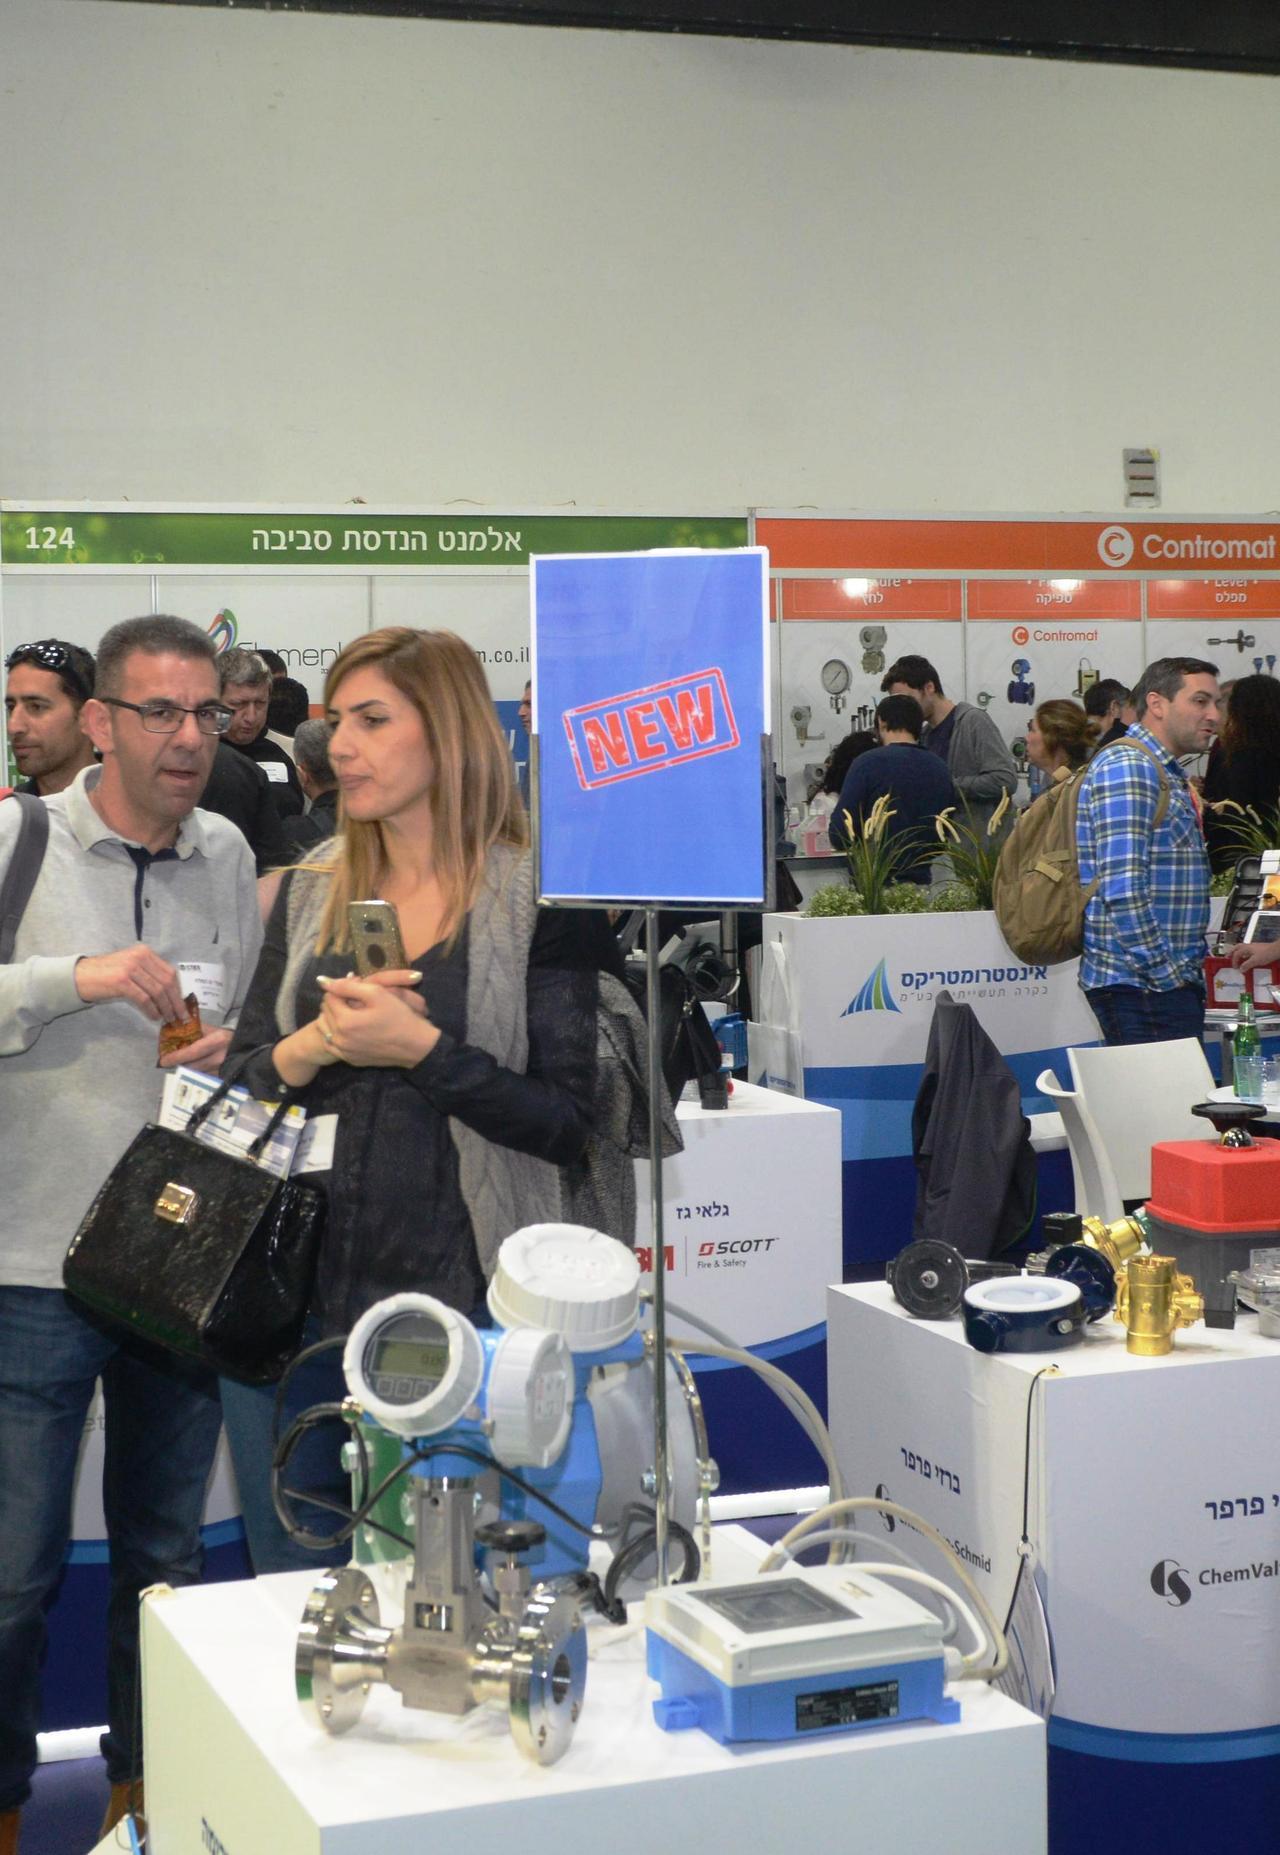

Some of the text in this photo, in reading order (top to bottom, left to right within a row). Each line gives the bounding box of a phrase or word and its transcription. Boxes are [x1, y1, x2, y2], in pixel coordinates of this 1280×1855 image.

[25, 527, 75, 549] 124
[252, 526, 522, 552] אלמנט הנדסת סביבה
[1143, 535, 1277, 559] Contromat
[1215, 592, 1248, 604] מפלס
[1033, 629, 1099, 642] Contromat
[582, 683, 717, 773] NEW
[901, 965, 1048, 989] אינסטרומטריקס
[951, 988, 1007, 1000] תעשייתי
[676, 1201, 730, 1220] גלאי גז
[697, 1259, 747, 1269] Fire & Safety
[901, 1447, 961, 1495] ברזי פרפר
[1205, 1497, 1265, 1520] פרפר
